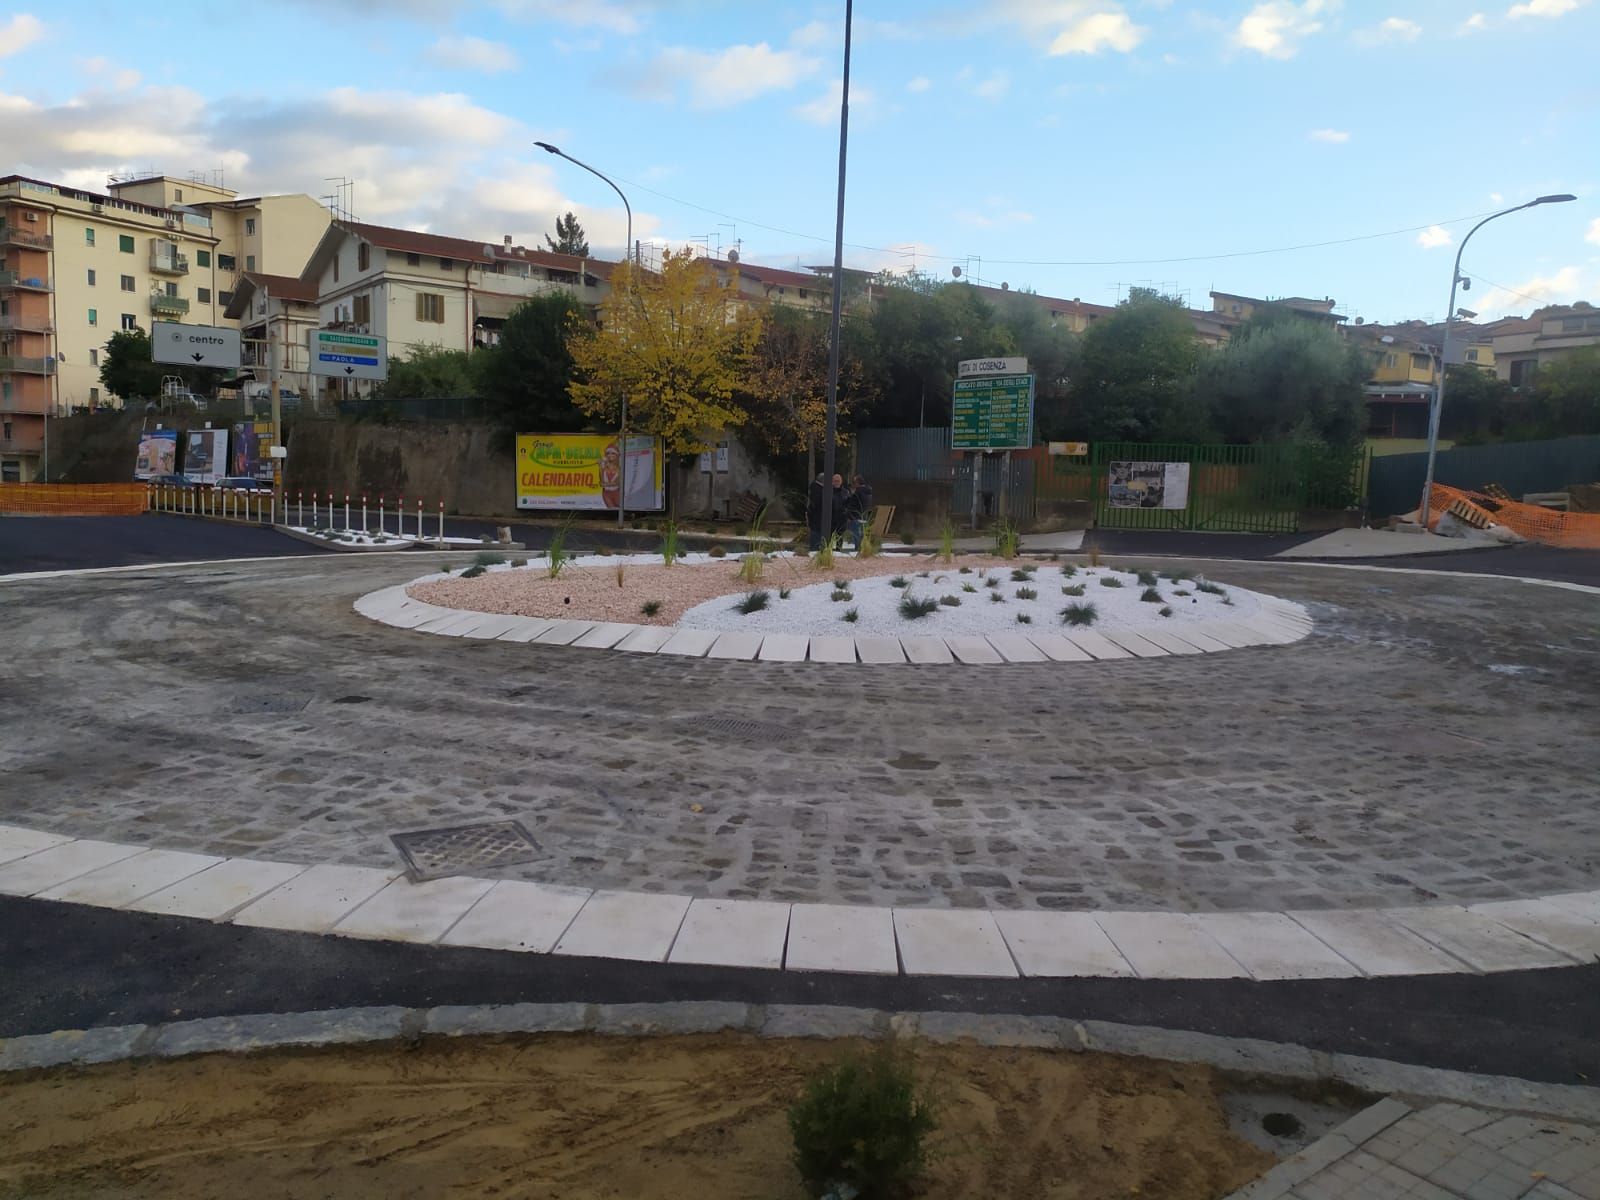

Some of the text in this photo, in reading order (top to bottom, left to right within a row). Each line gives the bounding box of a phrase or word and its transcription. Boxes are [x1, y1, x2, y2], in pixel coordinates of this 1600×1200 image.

[189, 336, 224, 345] centro
[332, 355, 355, 363] PAOLA
[972, 362, 978, 372] DI
[979, 360, 1007, 371] COSENZA
[522, 473, 594, 487] CALENDARIO
